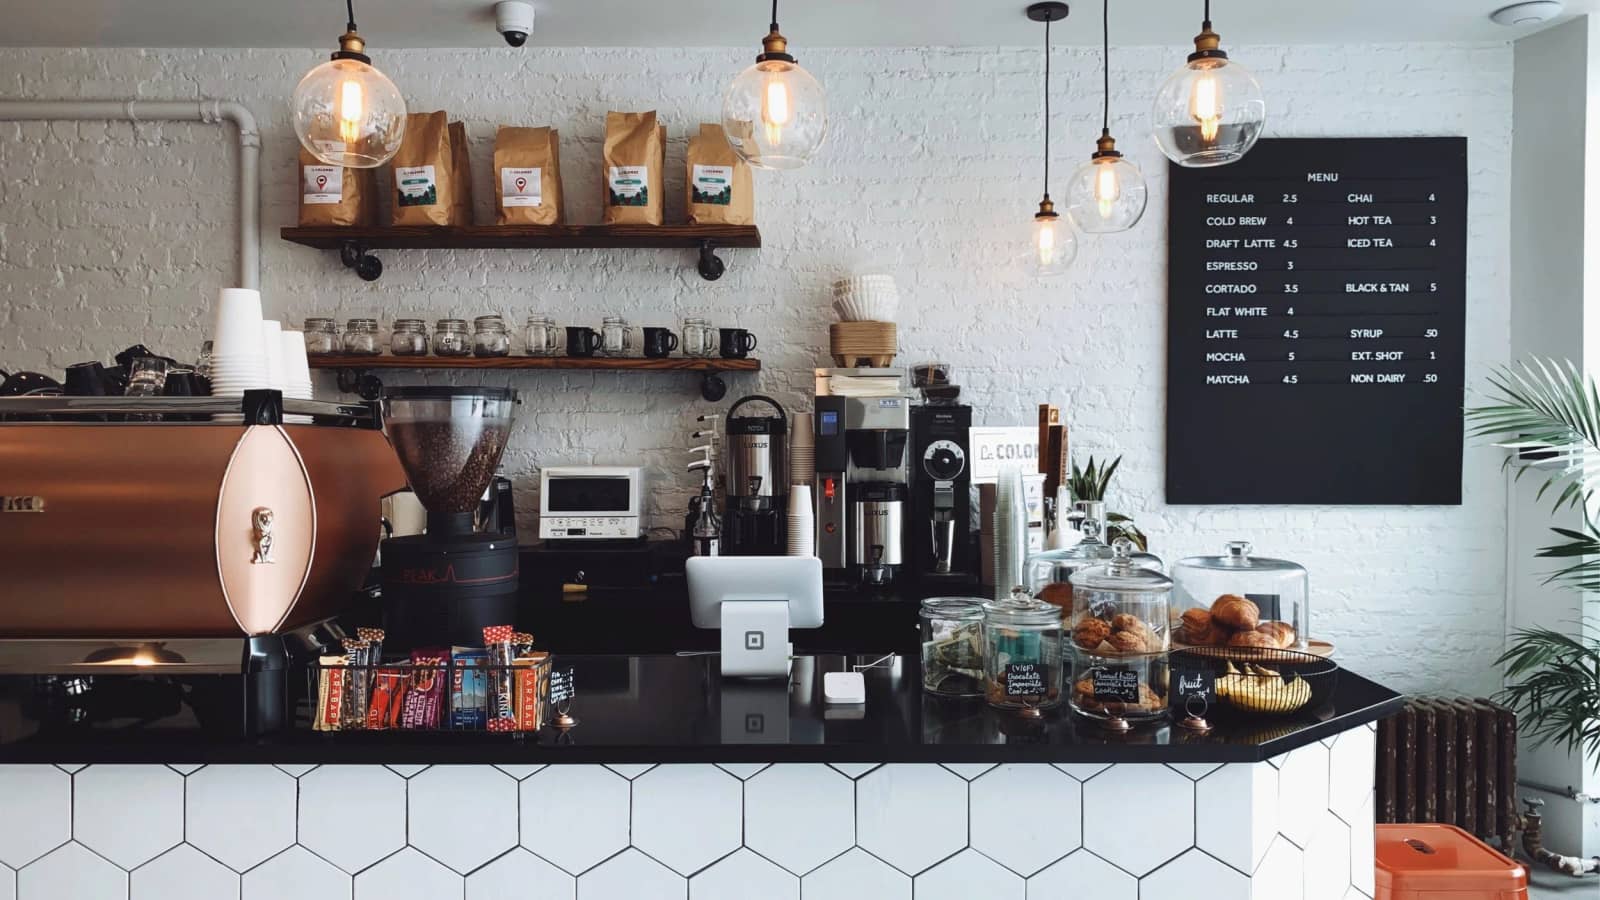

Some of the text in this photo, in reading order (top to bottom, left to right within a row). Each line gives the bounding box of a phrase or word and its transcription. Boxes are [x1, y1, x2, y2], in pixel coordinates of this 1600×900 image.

[1307, 173, 1339, 182] MENU
[1206, 193, 1298, 204] REGULAR 2.5
[1347, 193, 1436, 203] CHAI 4
[1206, 216, 1294, 226] COLD BREW 4
[1348, 215, 1437, 226] HOT TEA 3
[1206, 239, 1298, 249] DRAFT LATTE 4.5
[1347, 238, 1437, 248] ICED TEA 4
[1206, 261, 1294, 271] ESPRESSO 3
[1205, 283, 1299, 294] CORTADO 3.5
[1346, 282, 1437, 293] BLACK & TAN 5
[1206, 306, 1294, 317] FLAT WHITE 4
[1206, 329, 1299, 339] LATTE 4.5
[1350, 328, 1384, 339] SYRUP
[1206, 351, 1295, 362] MOCHA 5
[1351, 351, 1436, 361] EXT. SHOT 1
[1206, 374, 1298, 385] MATCHA 4.5
[1350, 373, 1438, 384] NON DAIRY .50
[1178, 673, 1204, 696] fruit
[524, 672, 534, 726] LARABAR
[499, 692, 510, 718] KIND
